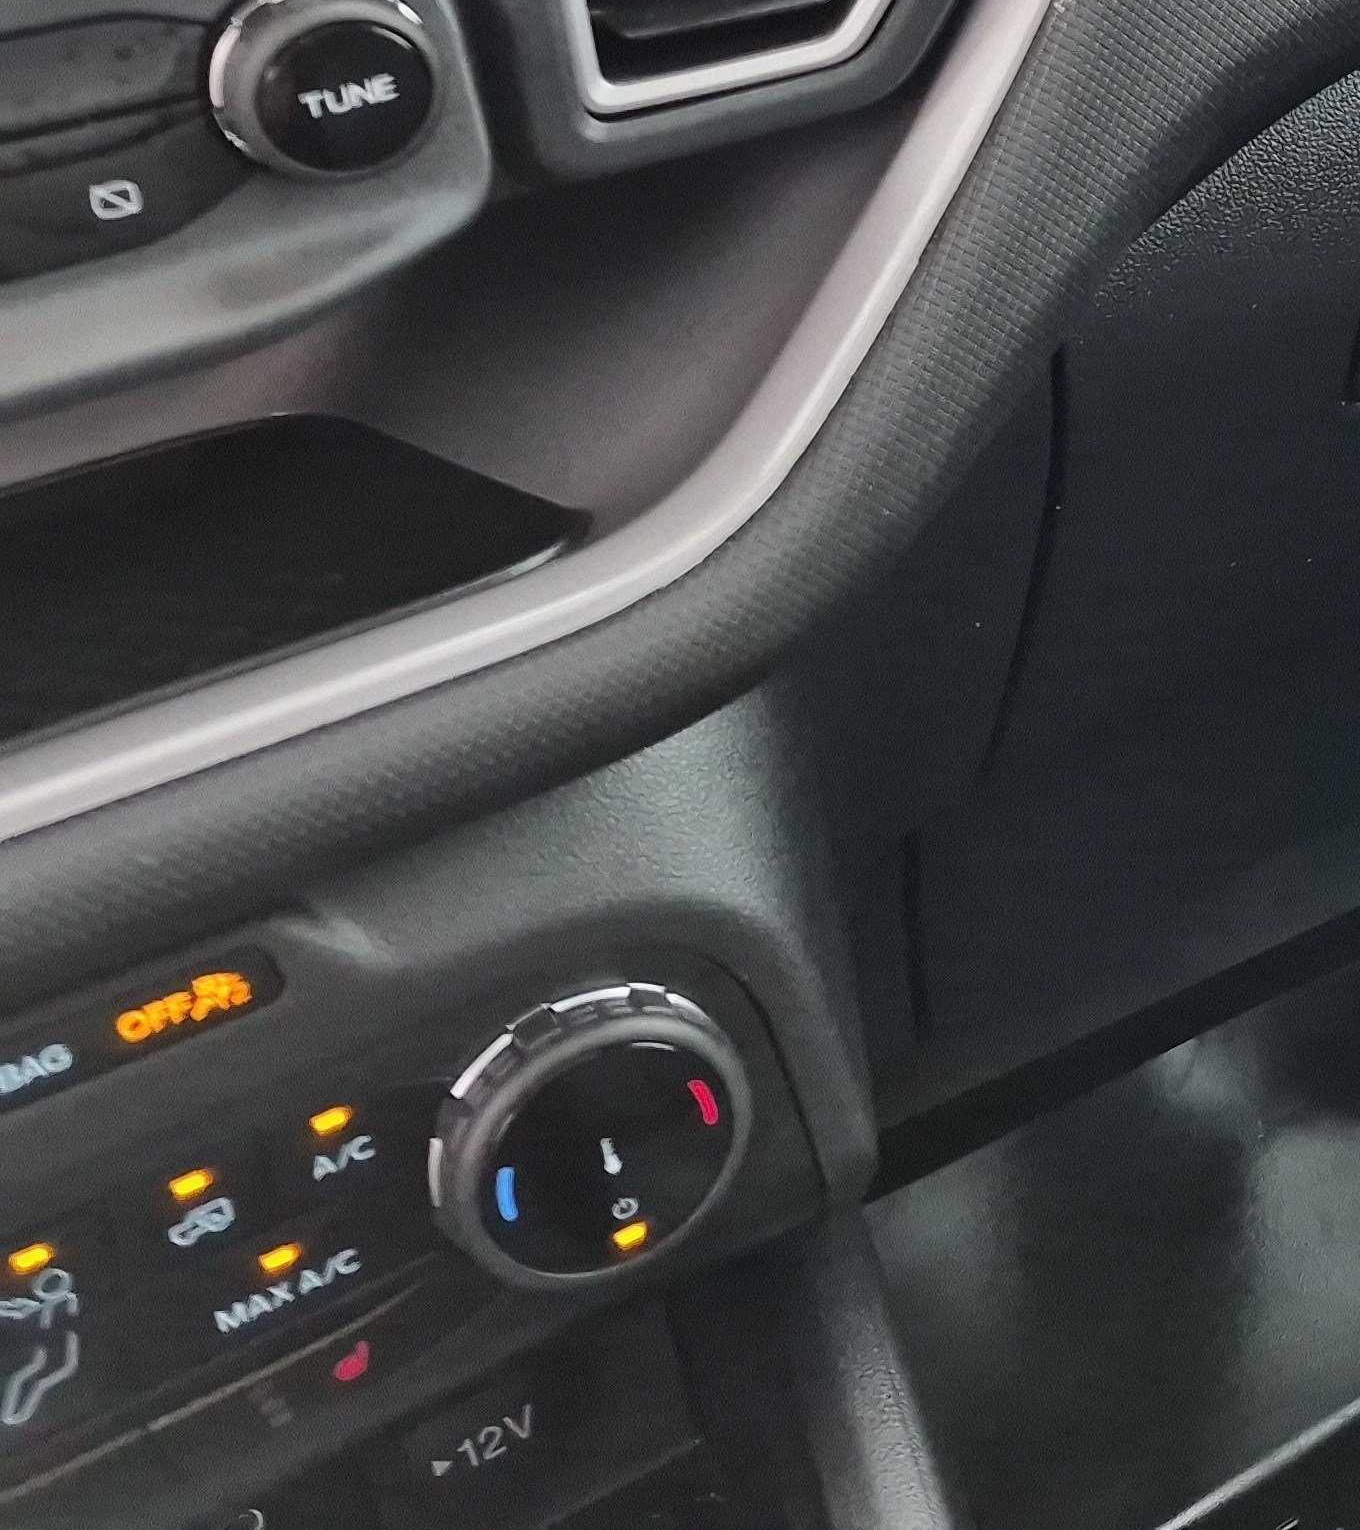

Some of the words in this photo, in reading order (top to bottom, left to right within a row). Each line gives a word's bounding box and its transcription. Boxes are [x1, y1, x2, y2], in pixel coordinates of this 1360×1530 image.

[297, 73, 400, 118] TUNE
[115, 991, 193, 1043] OFF
[313, 1135, 376, 1181] A/C
[213, 1282, 296, 1333] MAX
[299, 1248, 362, 1295] A/C
[456, 1403, 532, 1467] 12V
